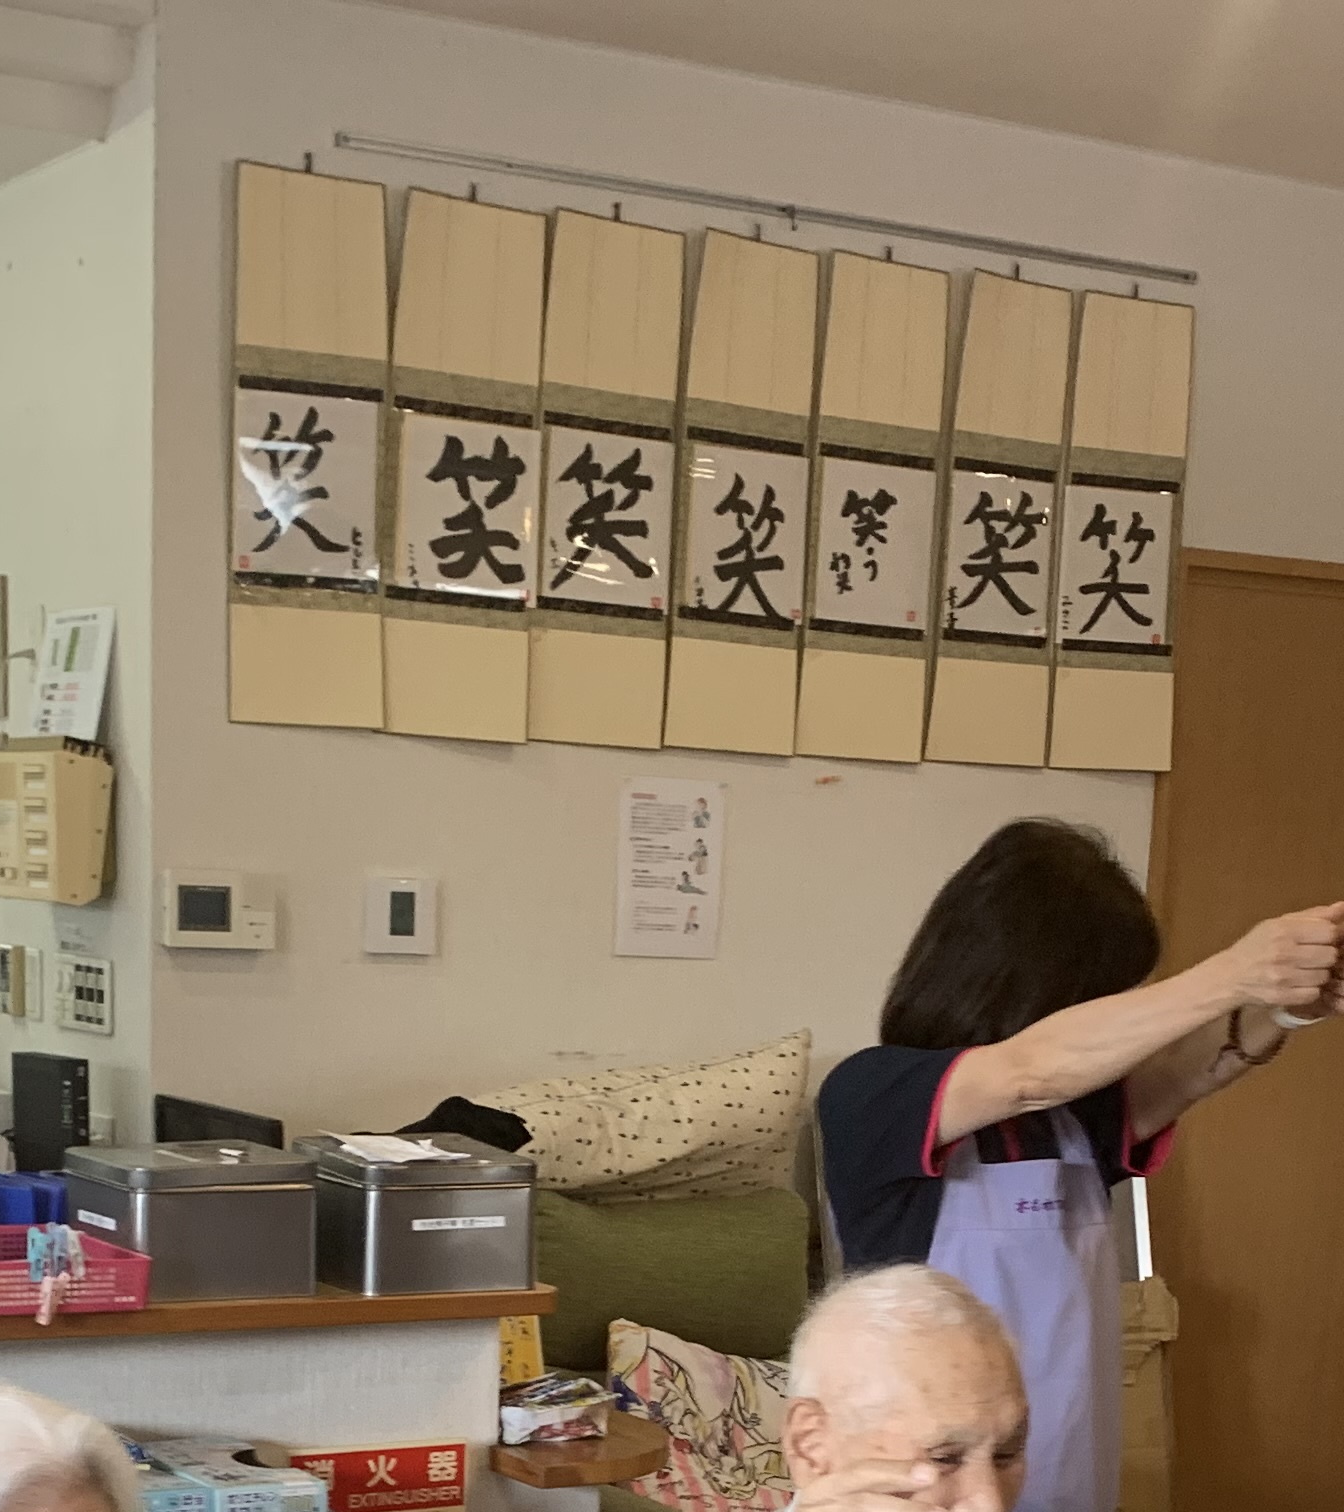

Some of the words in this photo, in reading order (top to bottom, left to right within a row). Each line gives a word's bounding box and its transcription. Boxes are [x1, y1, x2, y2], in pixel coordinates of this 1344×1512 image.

[426, 435, 527, 584] 笑
[551, 442, 654, 590] 笑
[714, 472, 796, 623] 笑
[956, 491, 1045, 615] 笑
[1079, 504, 1156, 634] 笑
